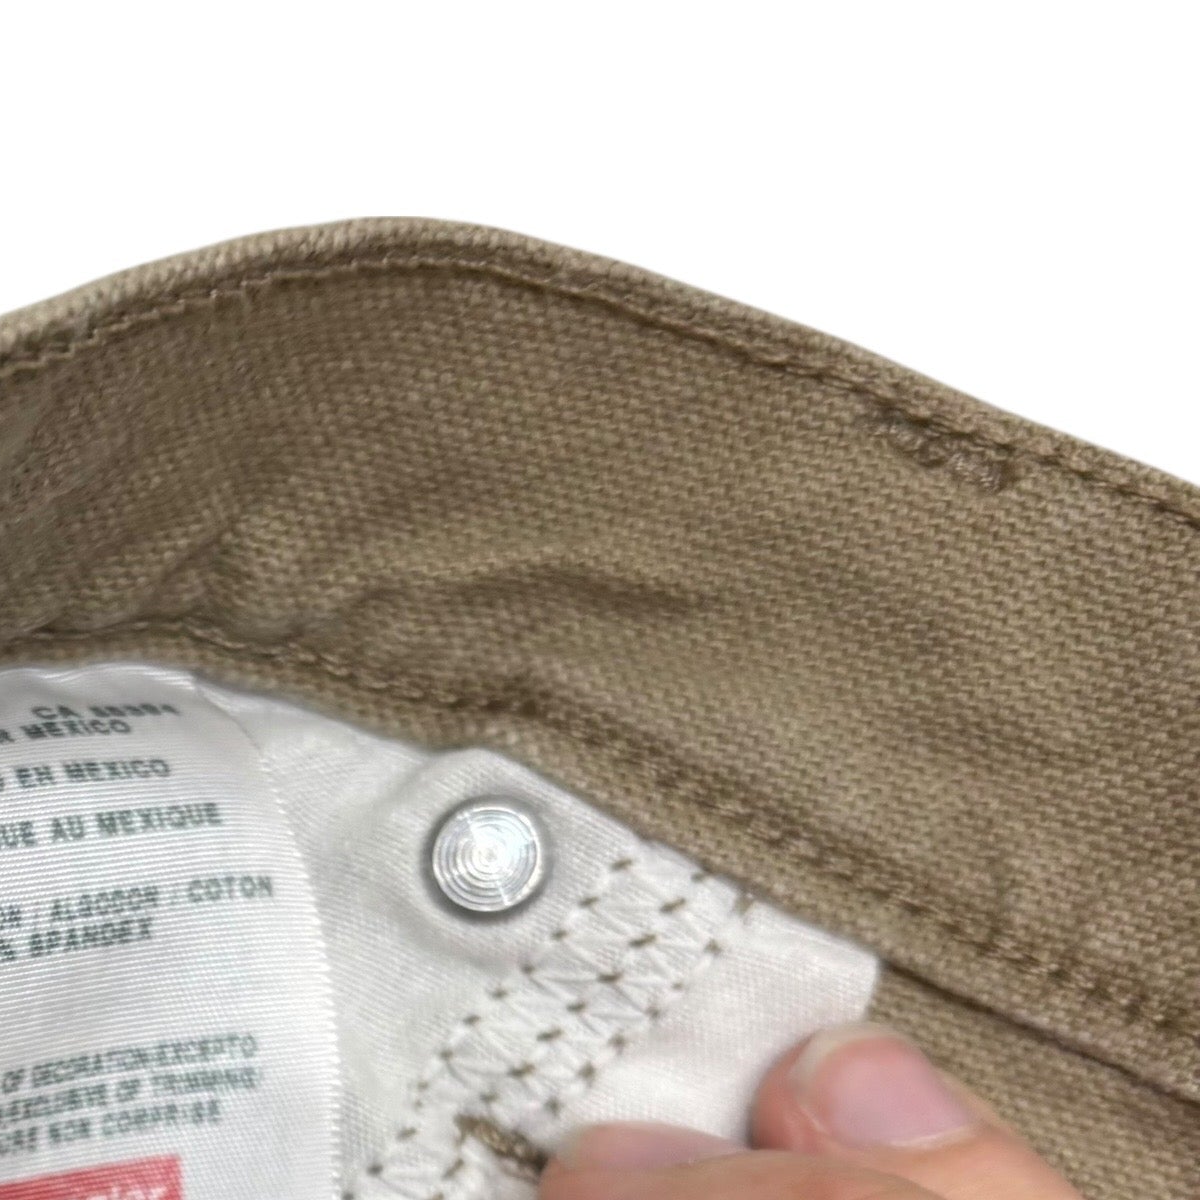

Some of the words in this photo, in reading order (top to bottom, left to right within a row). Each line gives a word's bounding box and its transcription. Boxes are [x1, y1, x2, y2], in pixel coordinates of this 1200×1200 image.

[30, 704, 81, 721] CA
[19, 719, 132, 741] MEXICO
[15, 764, 56, 789] EN
[63, 758, 171, 783] MEXICO
[50, 814, 84, 844] AU
[96, 801, 222, 840] MEXIQUE
[189, 874, 273, 904] COTON
[30, 916, 153, 959] SPANDEX
[2, 1068, 26, 1095] OF
[115, 1078, 142, 1103] OF
[50, 1116, 92, 1145] NON
